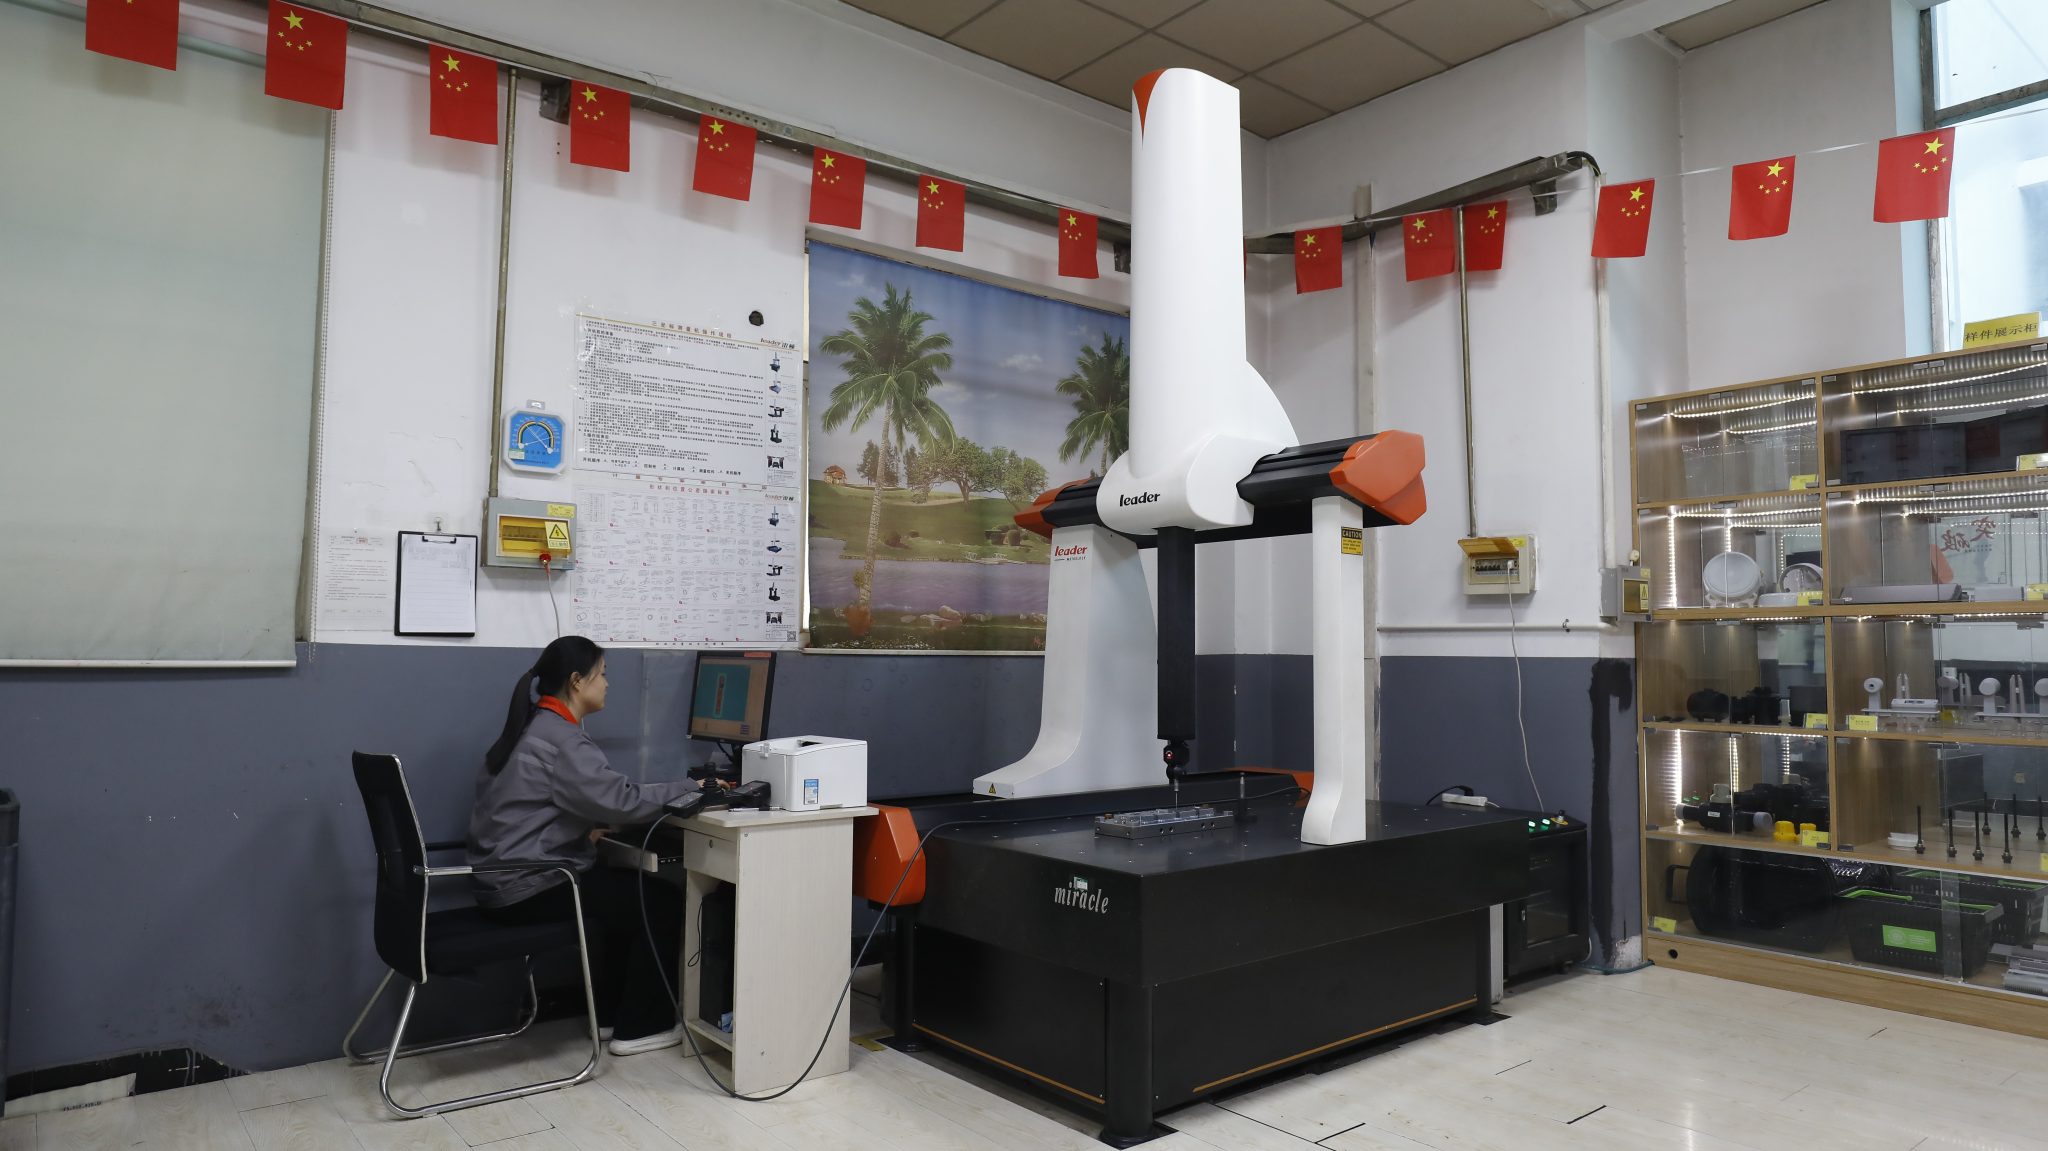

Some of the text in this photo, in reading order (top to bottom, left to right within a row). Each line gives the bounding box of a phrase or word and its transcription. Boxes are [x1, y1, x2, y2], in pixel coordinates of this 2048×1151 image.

[1964, 322, 2038, 342] 样件展示柜
[1119, 491, 1161, 507] leader
[1342, 530, 1362, 539] CAUTION
[1054, 545, 1088, 557] leader
[1054, 881, 1109, 914] miracle
